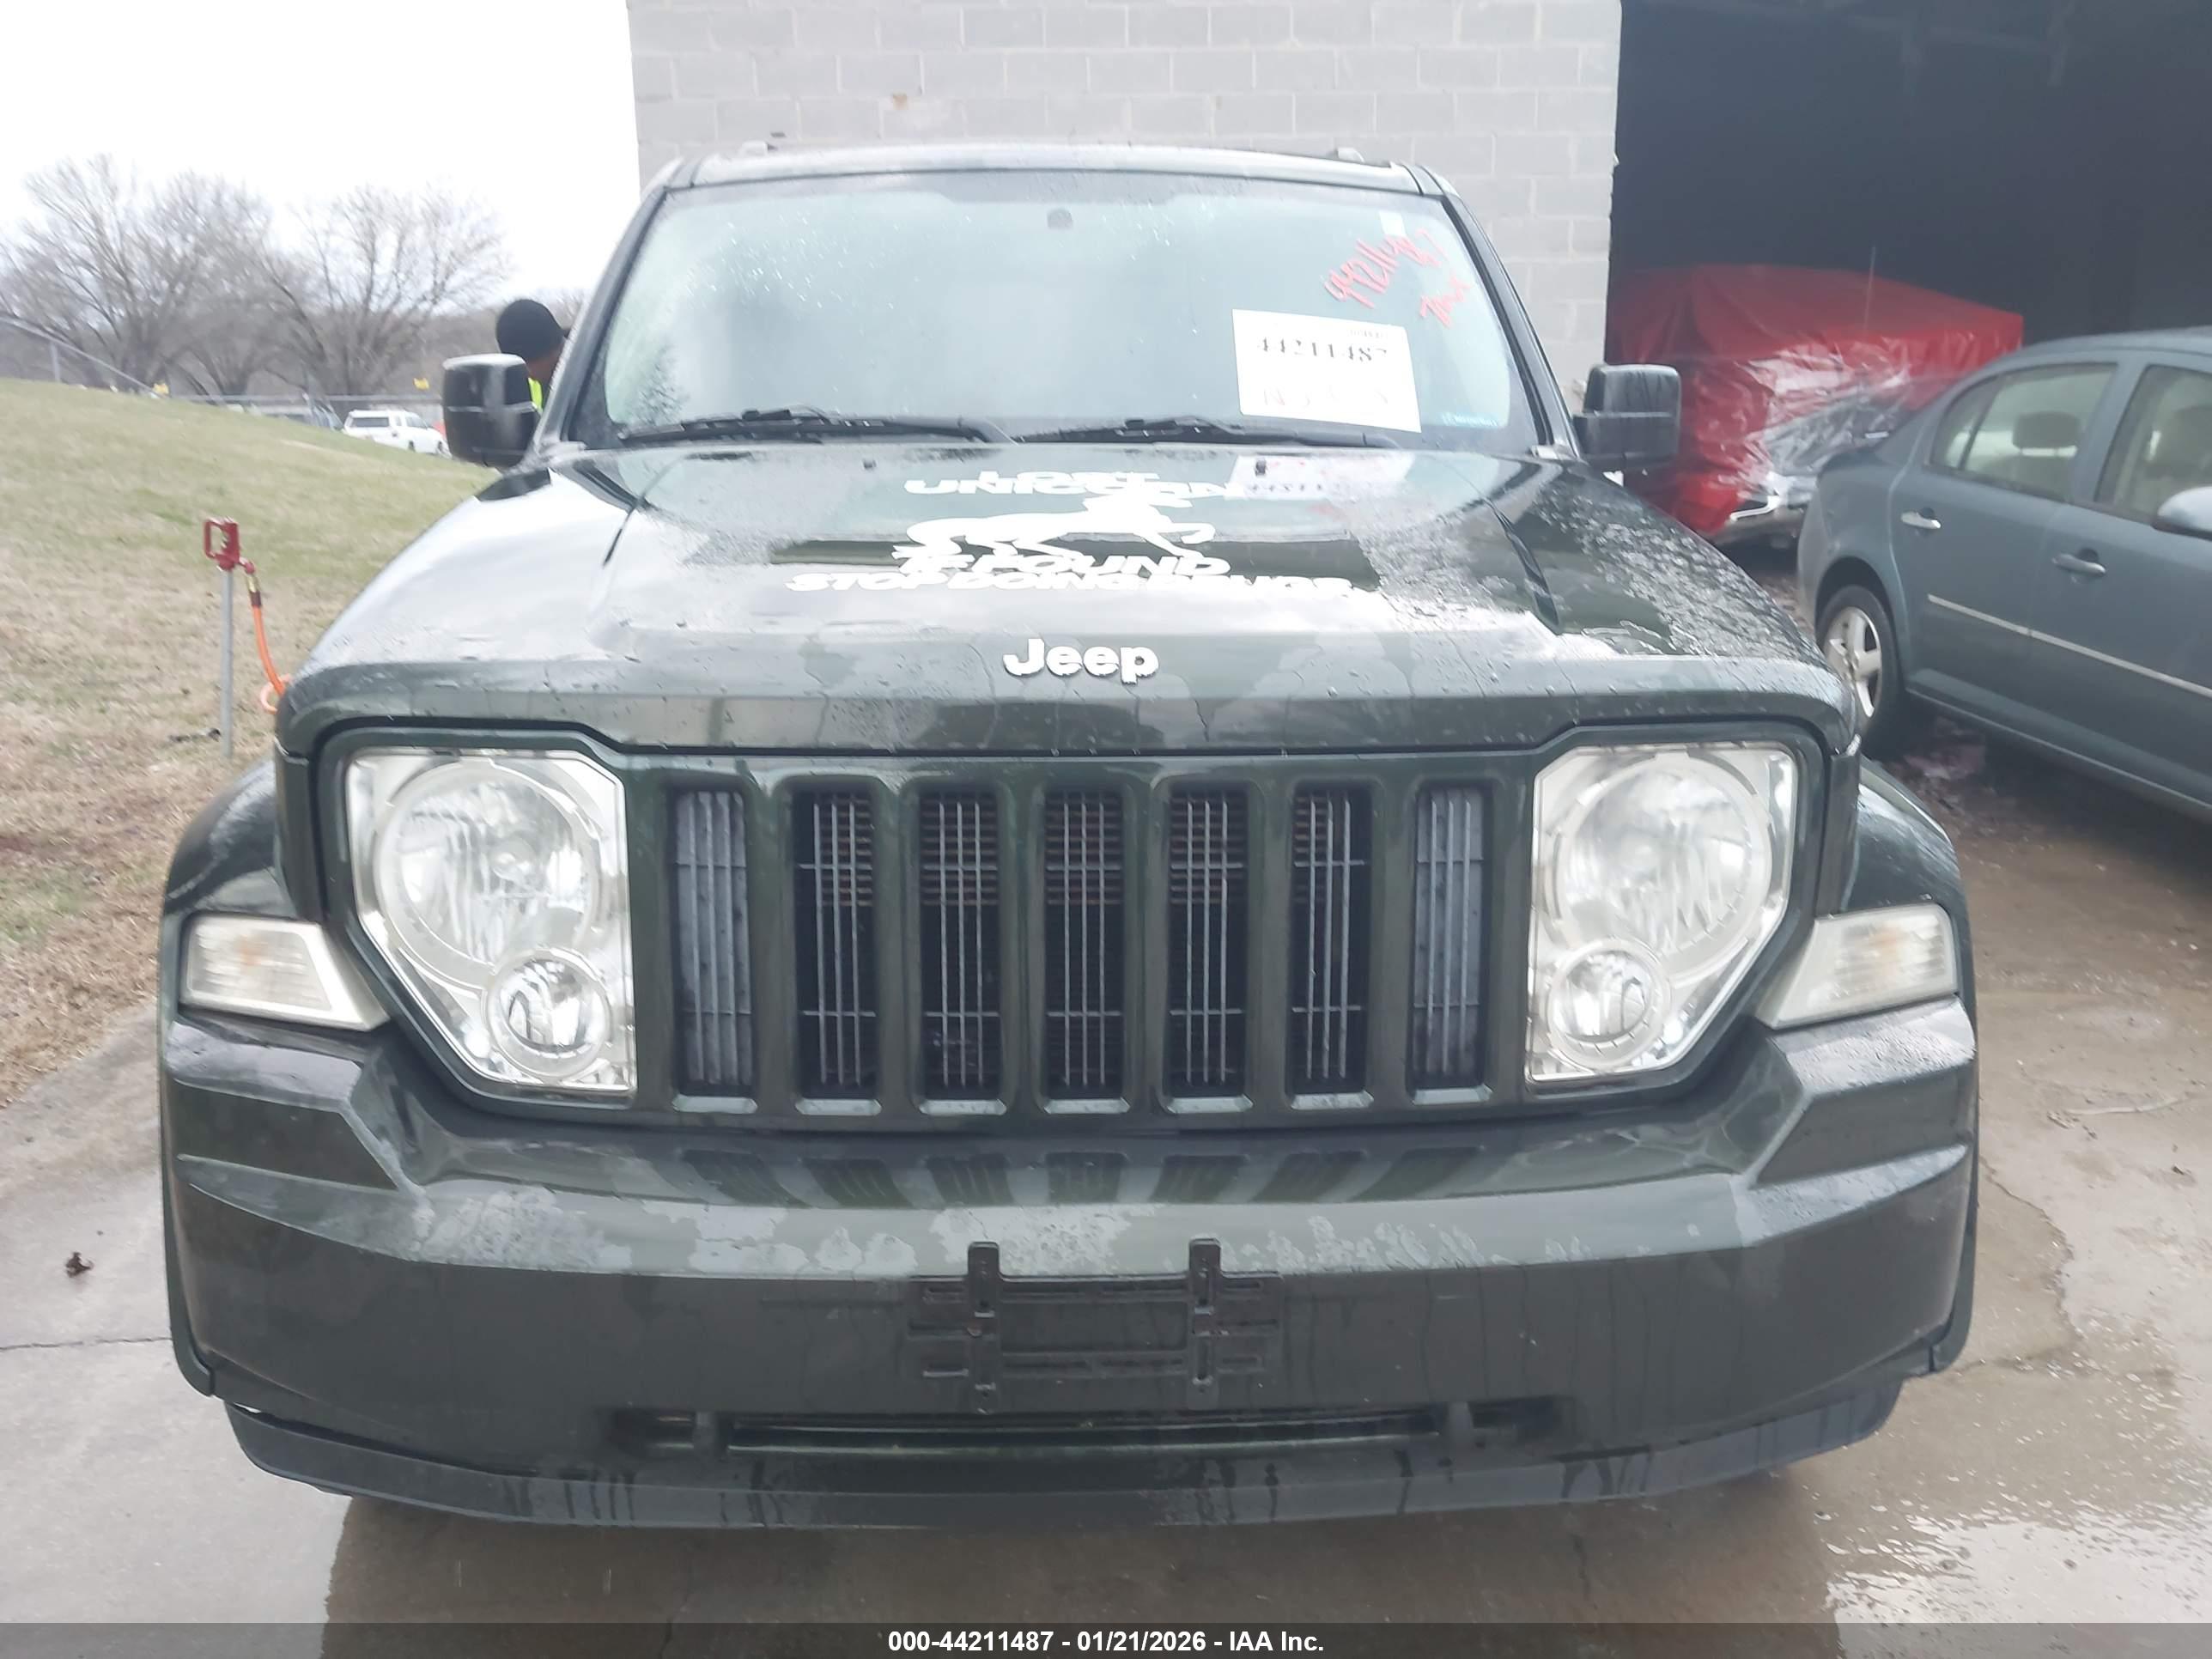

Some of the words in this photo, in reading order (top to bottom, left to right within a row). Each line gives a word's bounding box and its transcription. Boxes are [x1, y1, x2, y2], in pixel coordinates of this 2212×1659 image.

[970, 555, 1231, 576] FOUND
[784, 572, 949, 592] STOP
[945, 572, 1148, 592] DOING
[1002, 637, 1160, 684] Jeep
